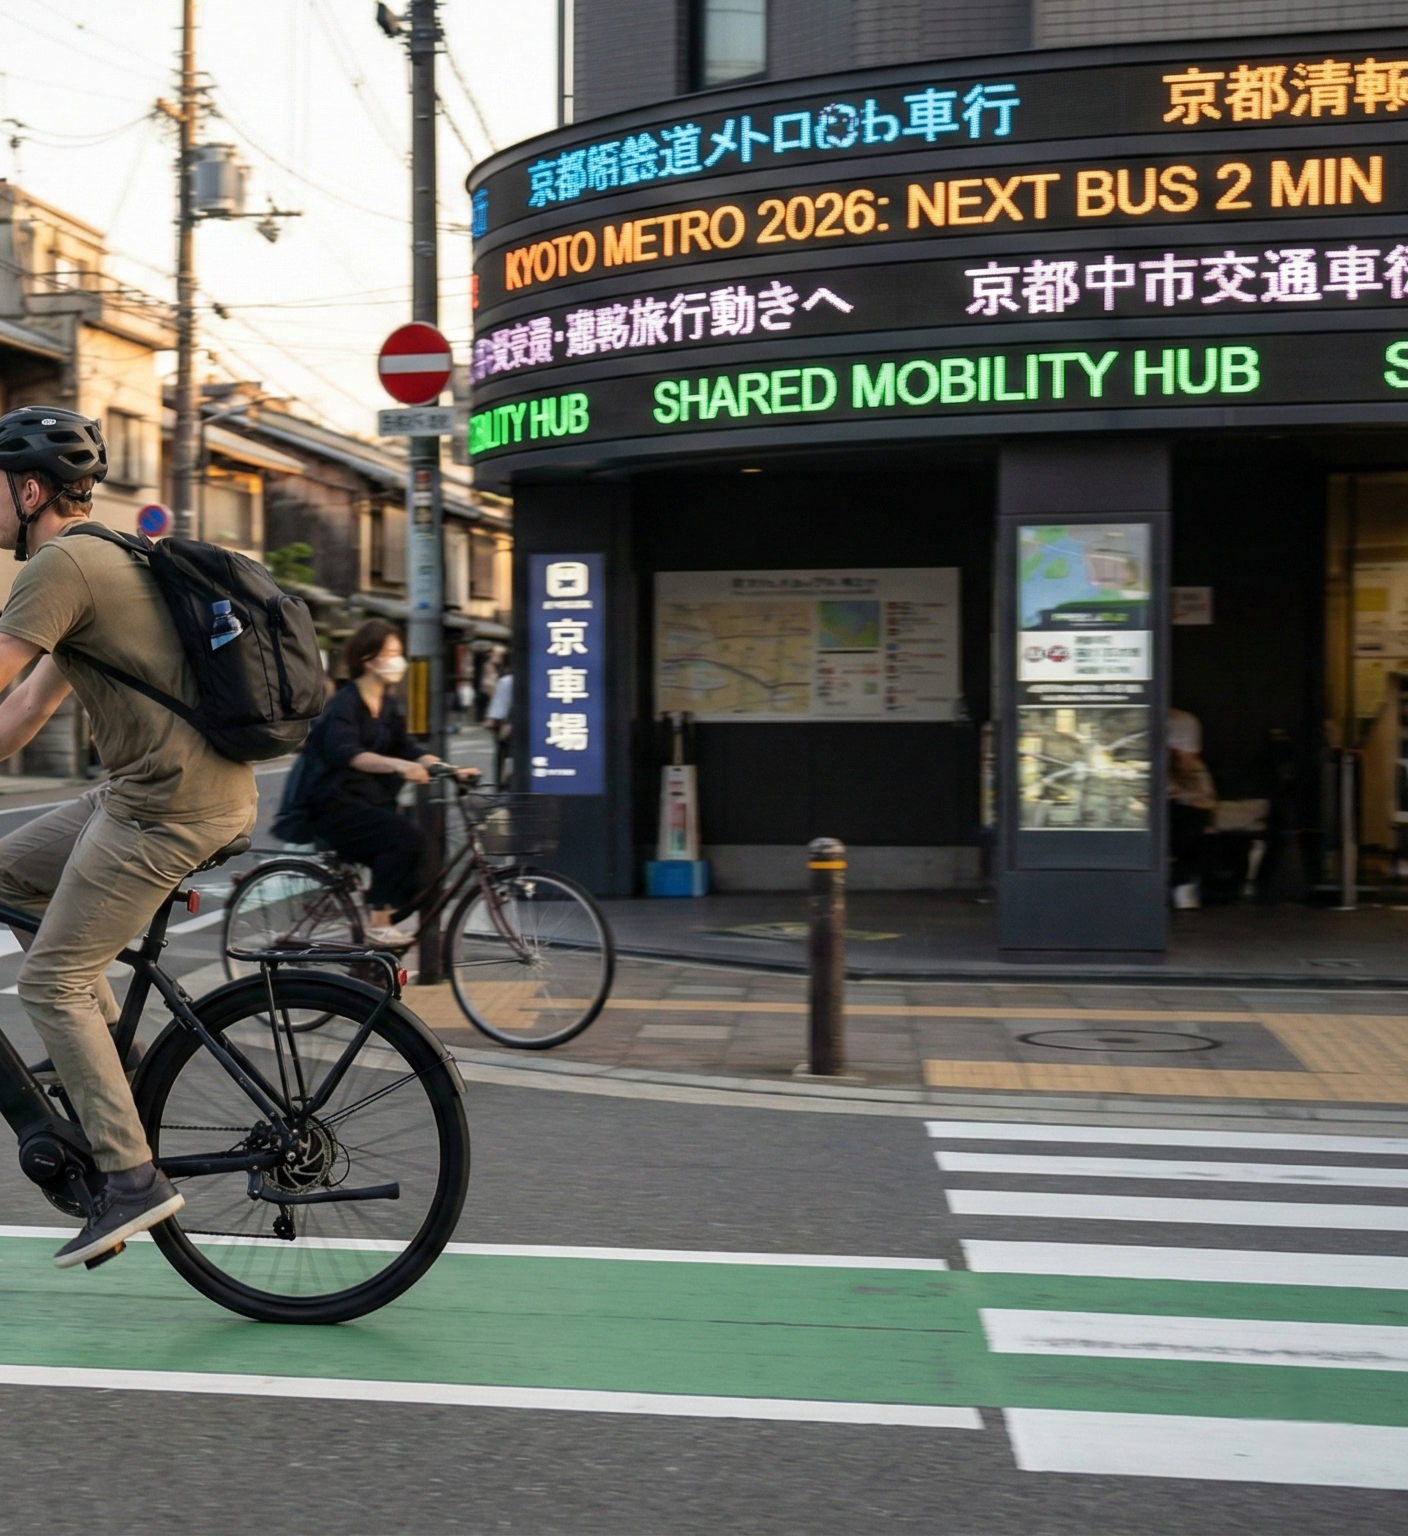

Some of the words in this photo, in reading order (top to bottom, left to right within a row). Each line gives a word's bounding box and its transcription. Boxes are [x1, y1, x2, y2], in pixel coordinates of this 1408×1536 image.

[505, 230, 597, 291] KYOTO
[603, 205, 746, 267] METRO
[756, 188, 890, 244] 2026:
[907, 173, 1061, 229] NEXT
[1076, 165, 1199, 217] BUS
[1215, 162, 1253, 210] 2
[1270, 155, 1383, 208] MIN
[529, 392, 590, 439] HUB
[653, 367, 838, 424] SHARED
[852, 350, 1119, 409] MOBILITY
[1134, 346, 1260, 396] HUB
